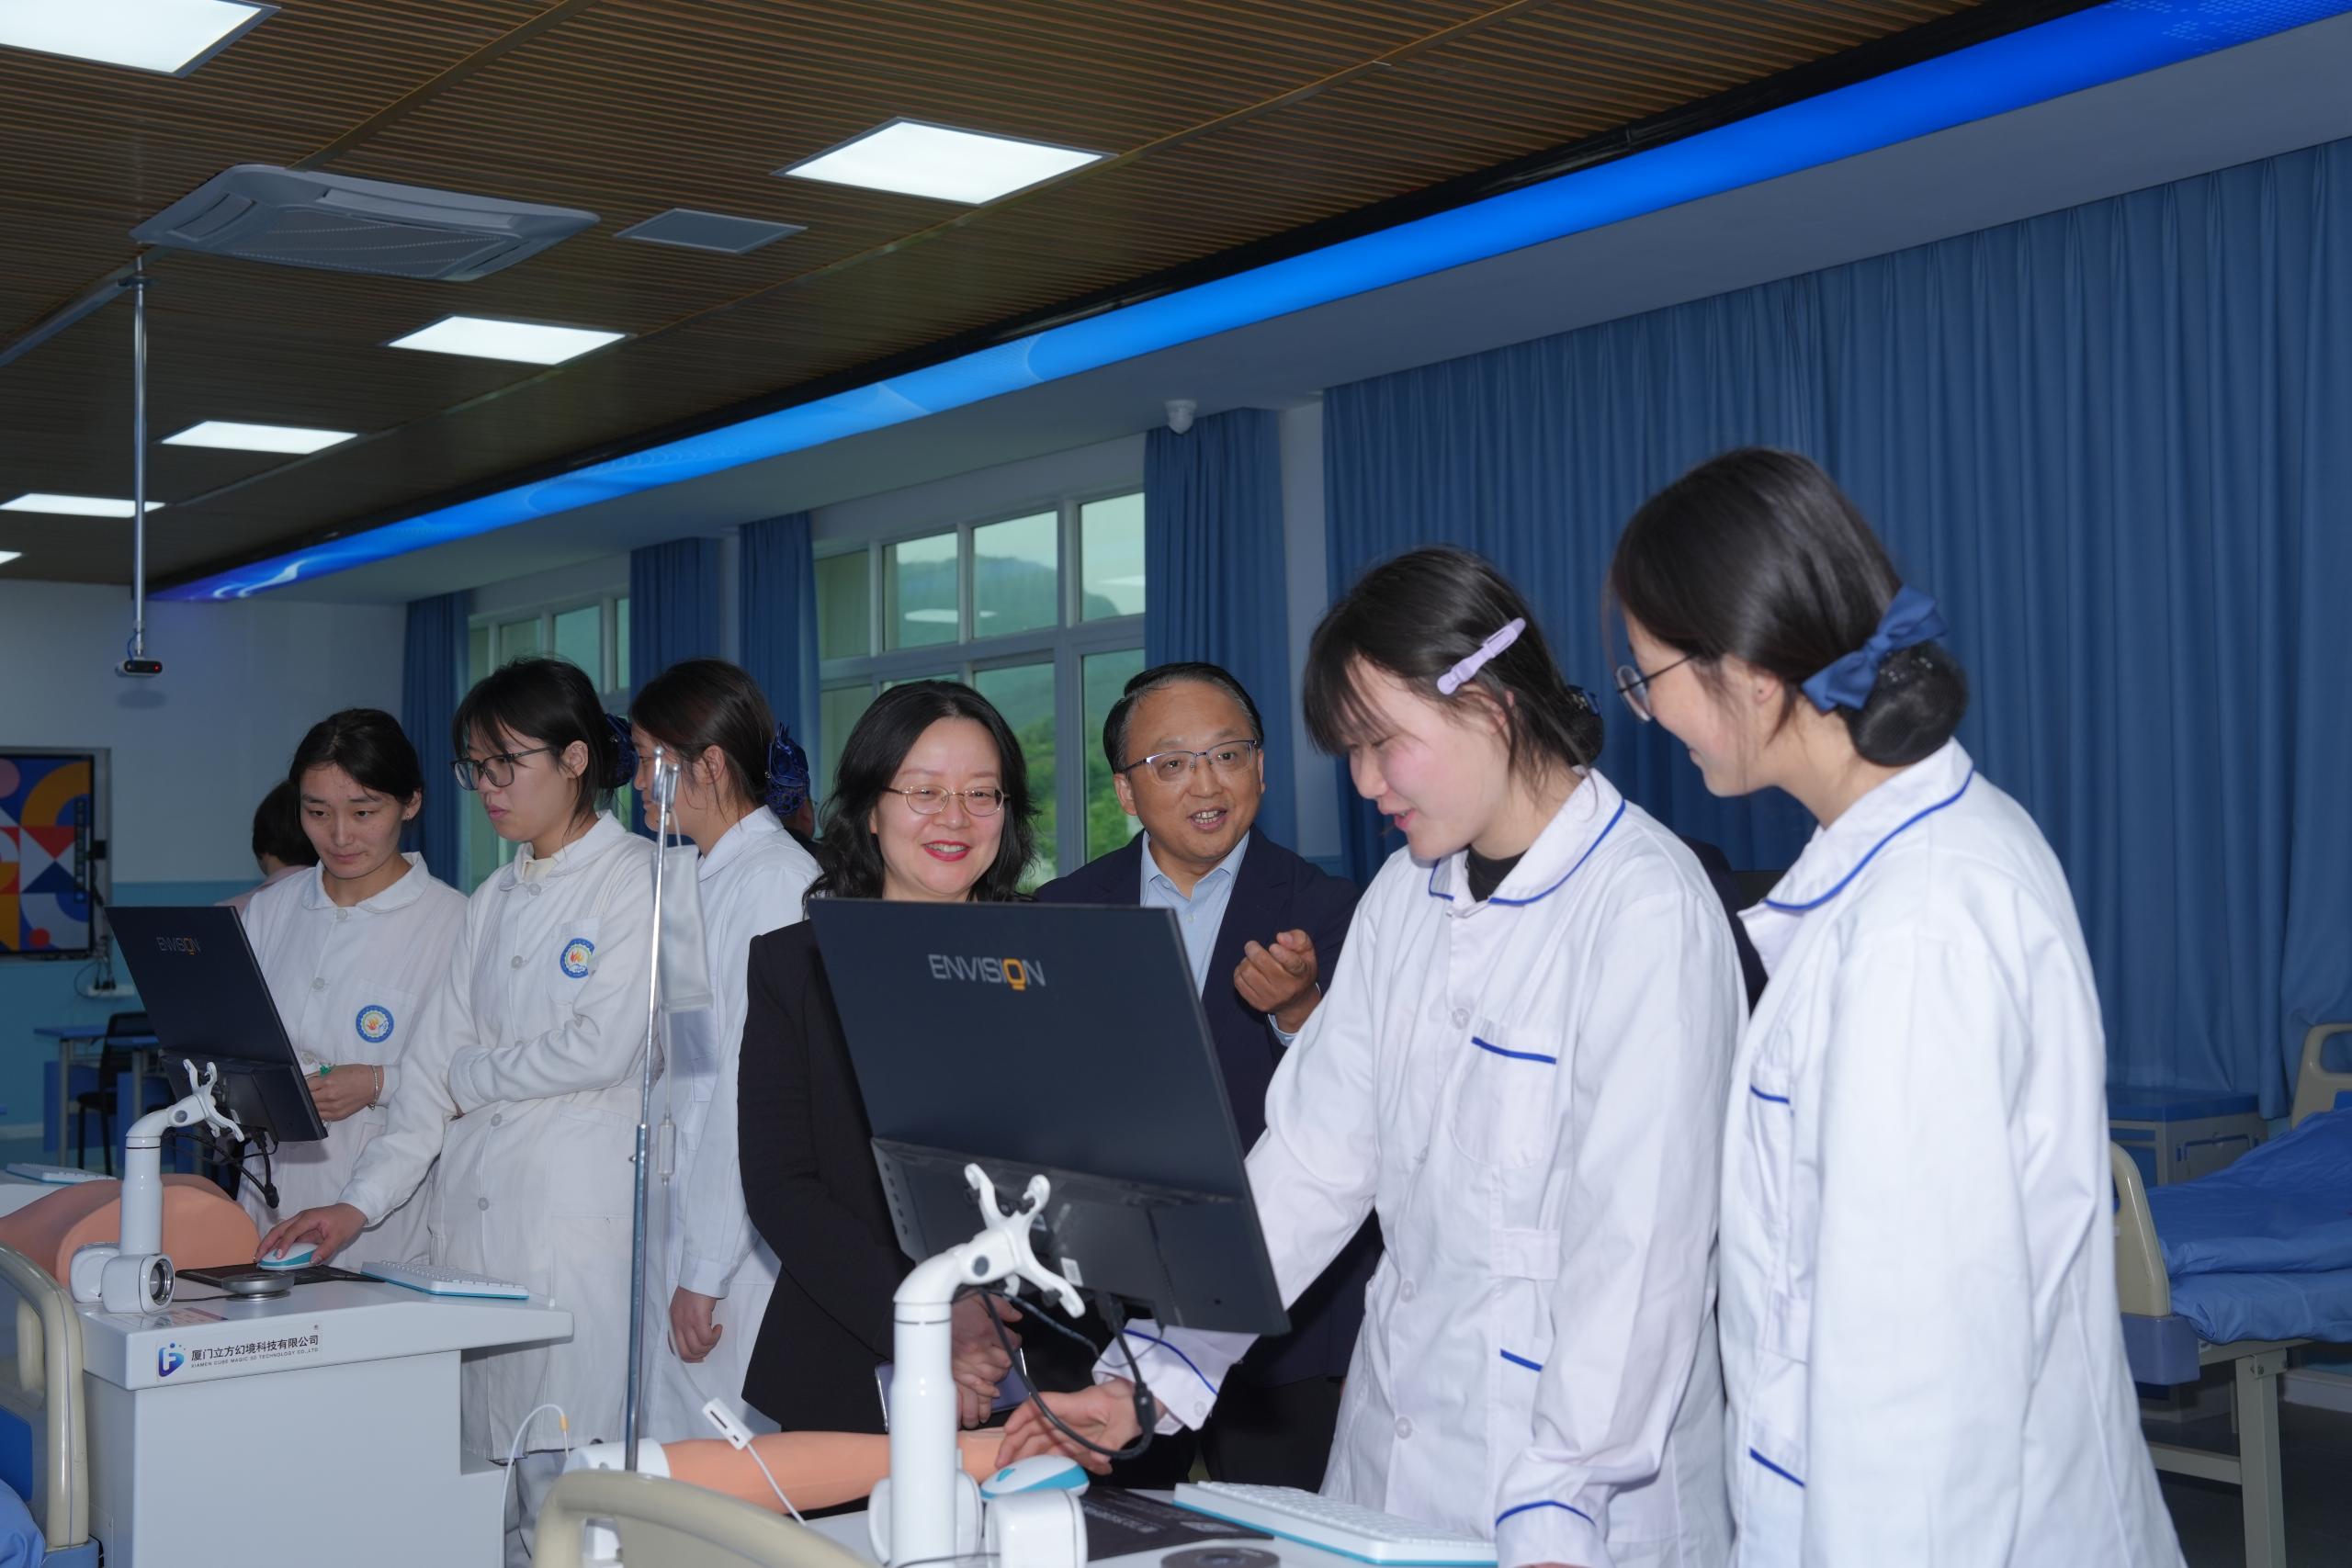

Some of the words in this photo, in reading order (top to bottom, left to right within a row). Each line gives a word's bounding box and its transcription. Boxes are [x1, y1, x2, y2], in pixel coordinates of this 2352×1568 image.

[927, 953, 1046, 991] ENVISION
[191, 1335, 319, 1361] 厦门立方幻境科技有限公司
[259, 1350, 296, 1359] TECHNOLOGY
